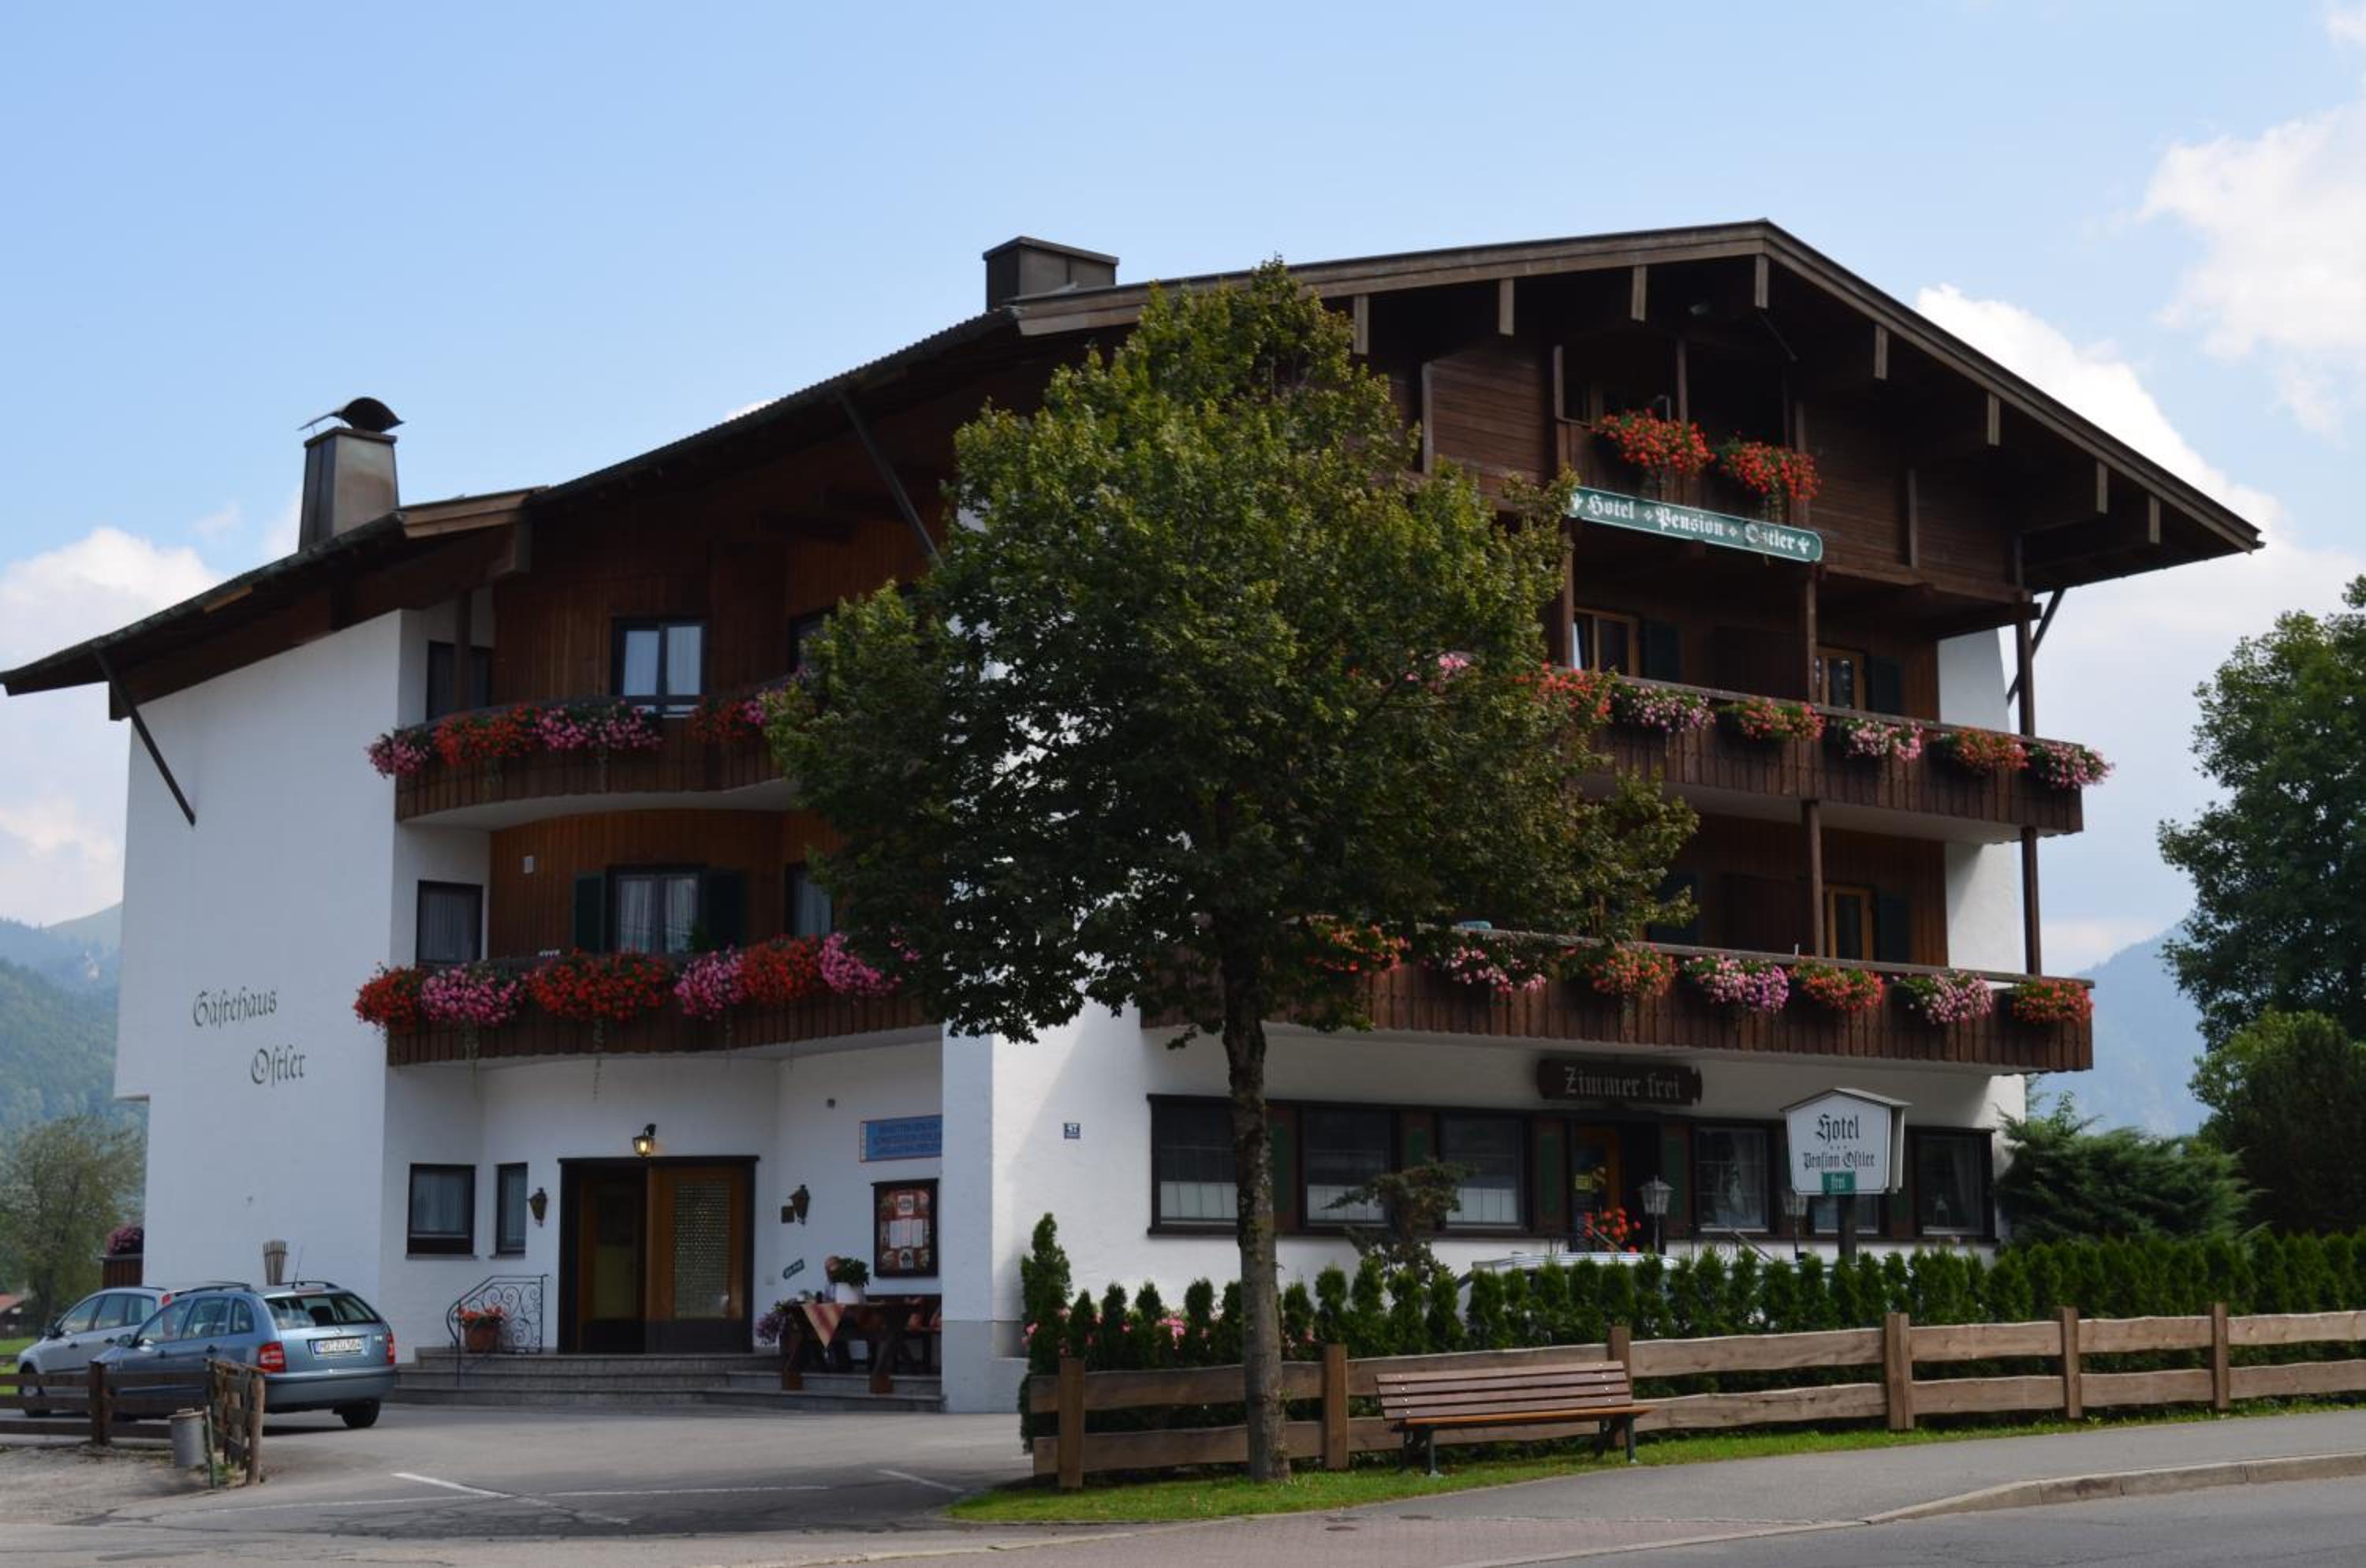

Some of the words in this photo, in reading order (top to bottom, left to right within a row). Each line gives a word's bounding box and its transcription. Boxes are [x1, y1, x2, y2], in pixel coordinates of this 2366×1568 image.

[1587, 494, 1635, 520] Hotel
[1655, 506, 1724, 537] Pension
[1564, 1066, 1640, 1097] Zimmer
[1648, 1072, 1680, 1099] frei
[1816, 1113, 1860, 1143] Hotel
